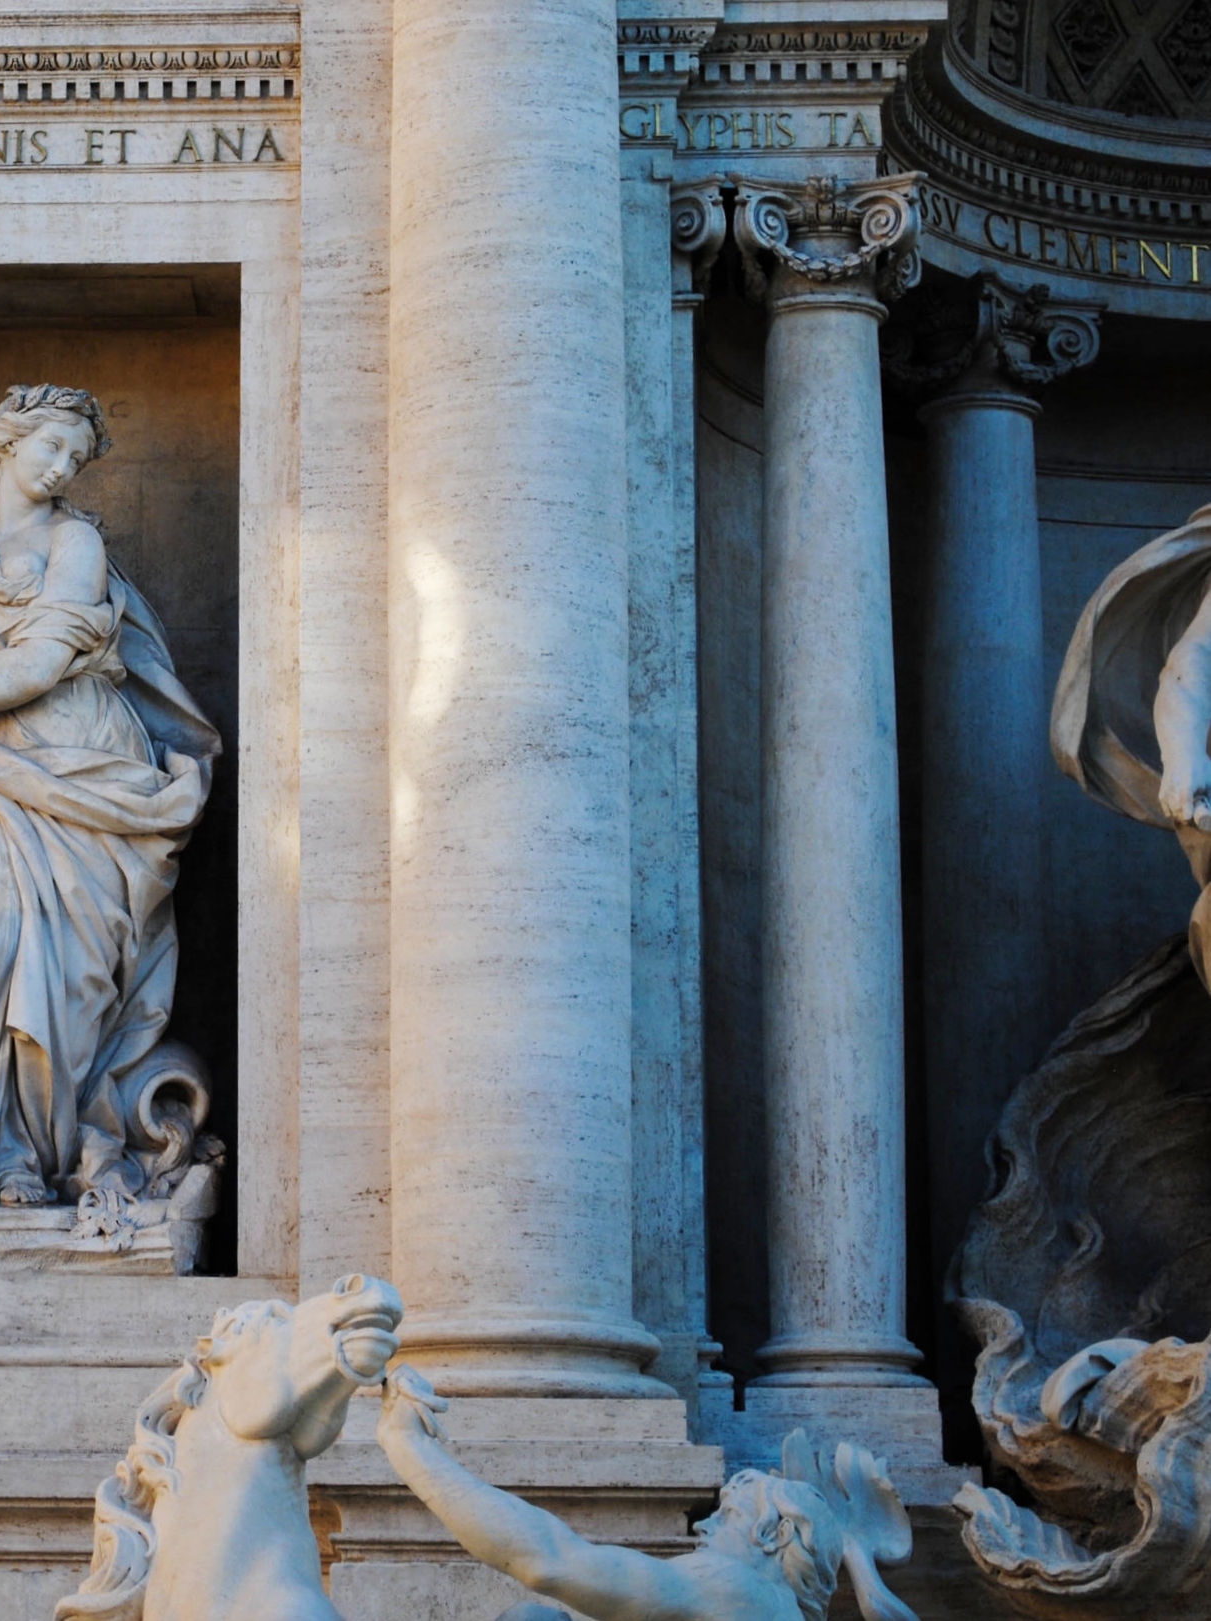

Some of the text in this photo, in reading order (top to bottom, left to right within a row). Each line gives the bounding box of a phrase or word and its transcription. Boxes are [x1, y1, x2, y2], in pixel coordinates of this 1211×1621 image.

[83, 129, 137, 165] ET
[174, 127, 286, 164] ANA
[619, 103, 877, 150] GLYPHIS TA
[919, 185, 1211, 284] SSV CLEMENT
